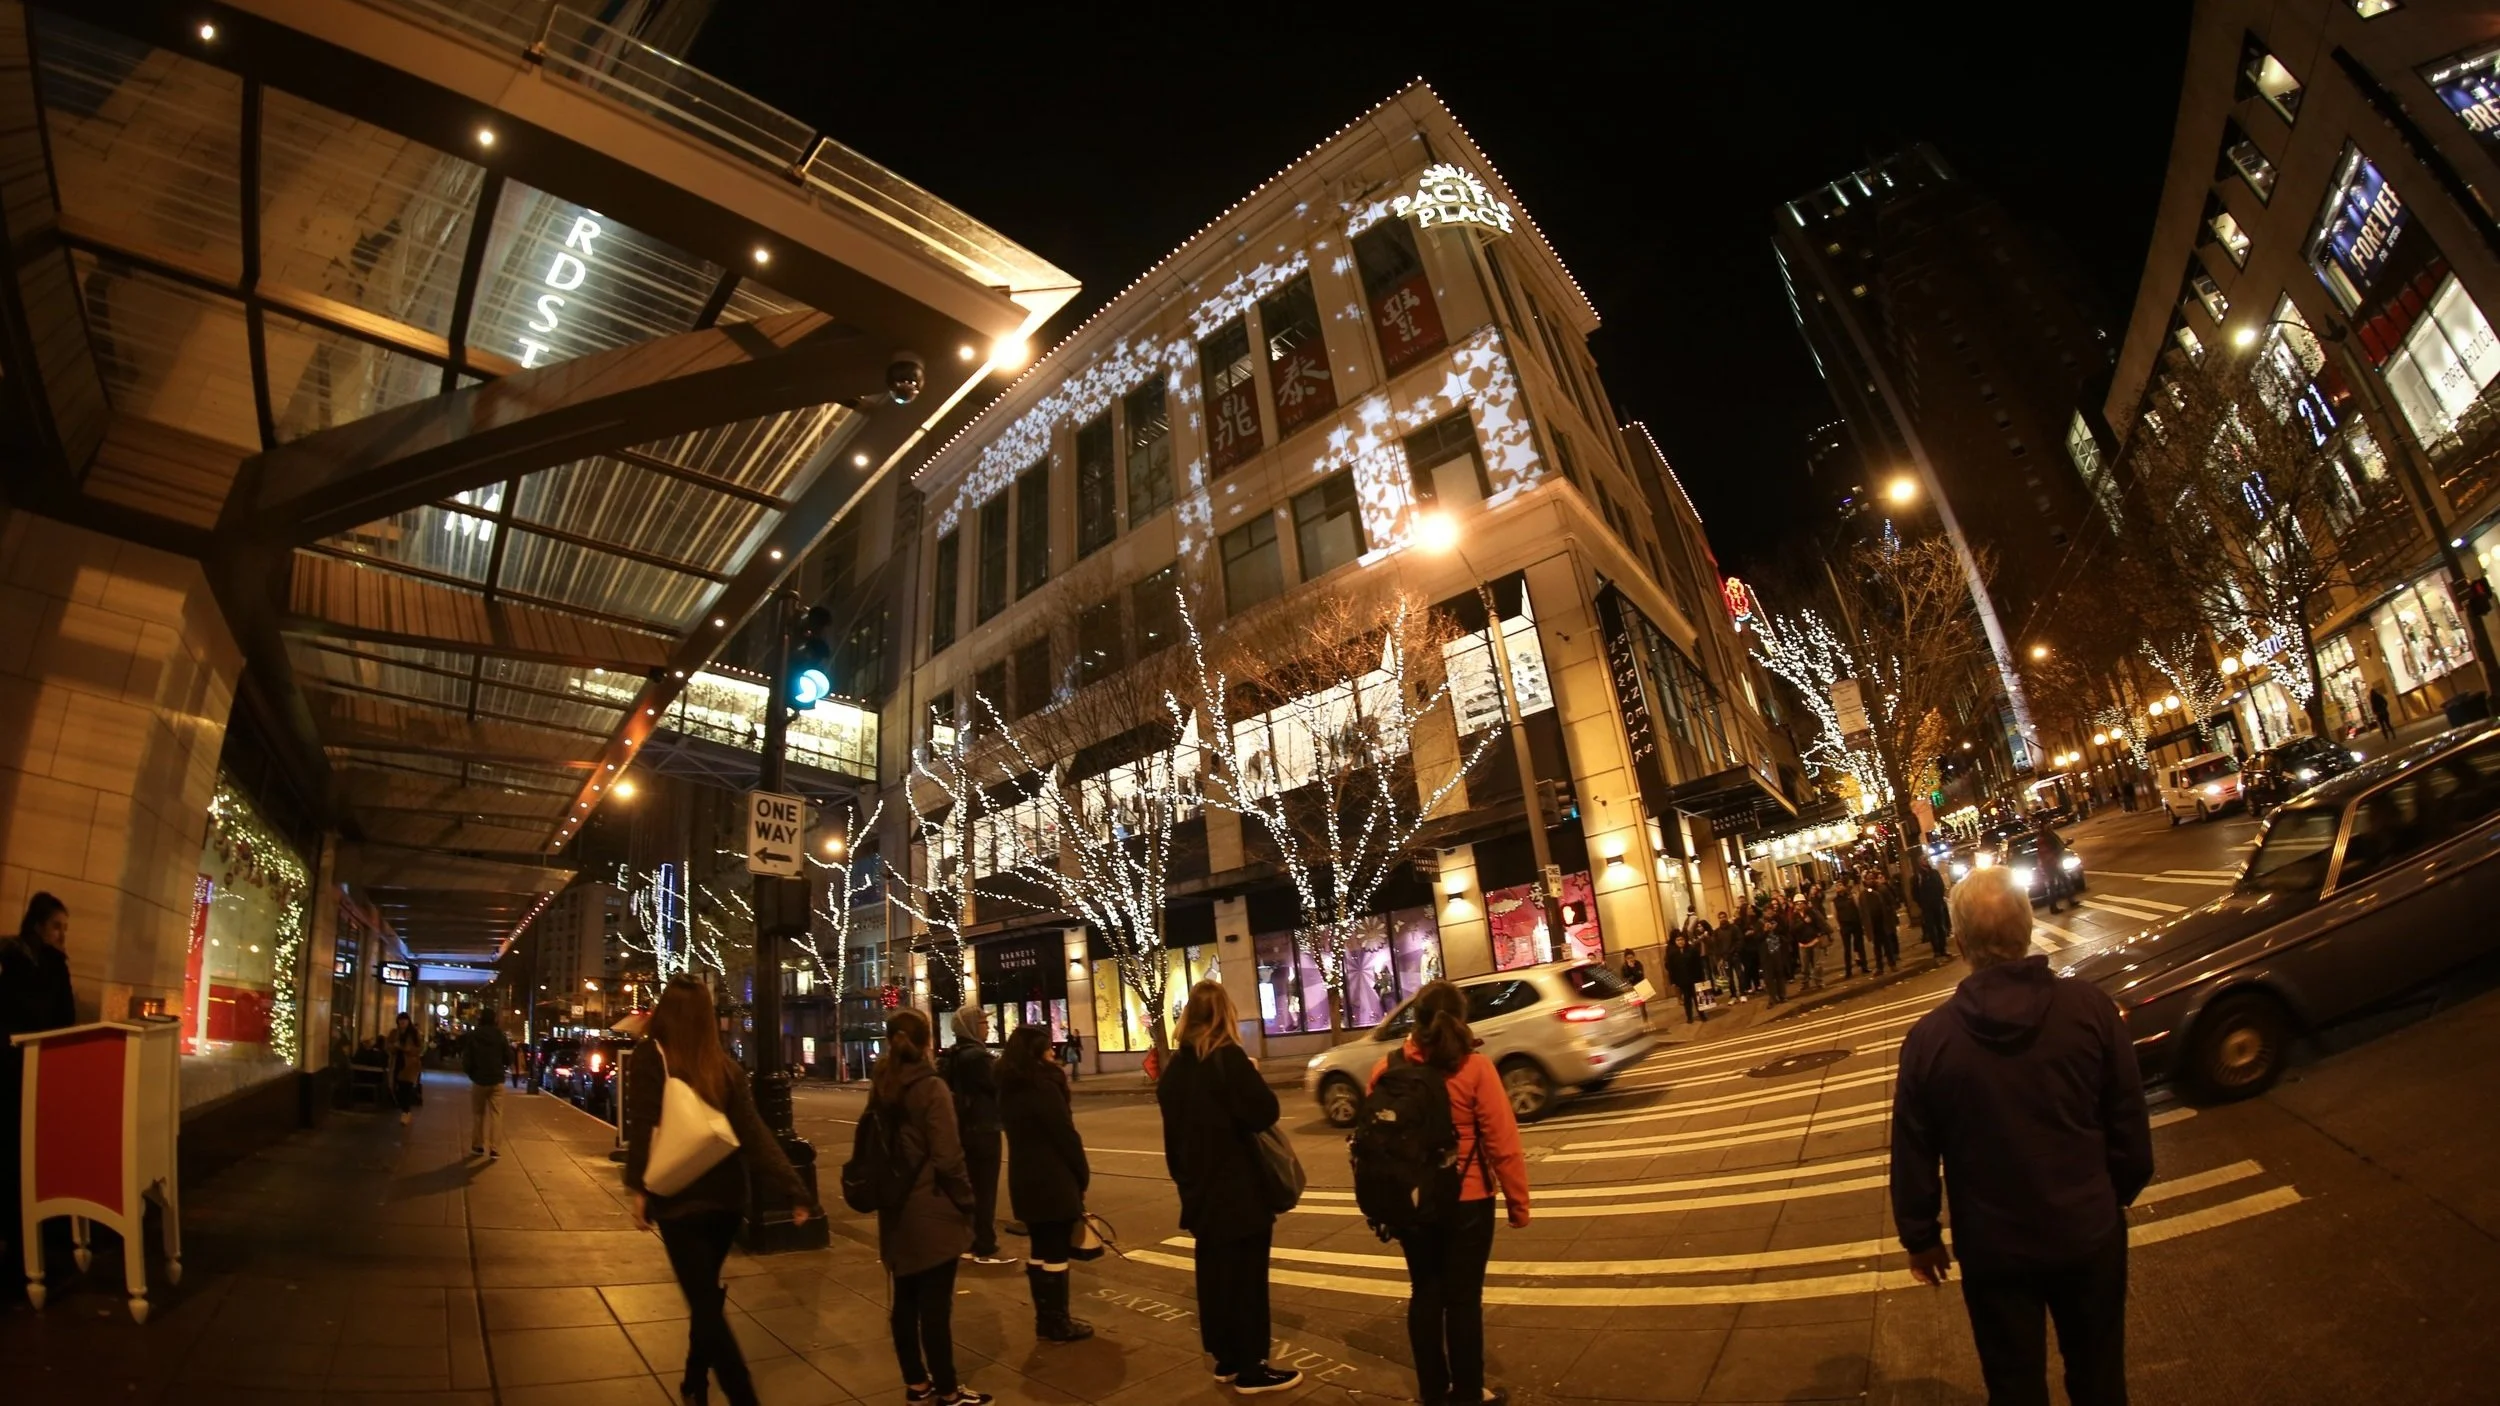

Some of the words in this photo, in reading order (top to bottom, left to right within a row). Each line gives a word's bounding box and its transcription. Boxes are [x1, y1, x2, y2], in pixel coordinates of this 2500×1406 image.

[1392, 185, 1514, 221] PACIFIC
[1417, 205, 1513, 233] PLACE
[2440, 325, 2495, 393] FOREER21.CO
[1277, 355, 1330, 407] 泰
[2298, 383, 2336, 446] 21
[1617, 632, 1654, 754] BARNEYS
[757, 799, 797, 823] ONE
[755, 820, 798, 845] WAY
[1000, 949, 1036, 960] BARNEYS
[1089, 1288, 1194, 1323] SIXTH
[1270, 1337, 1358, 1383] NUE
